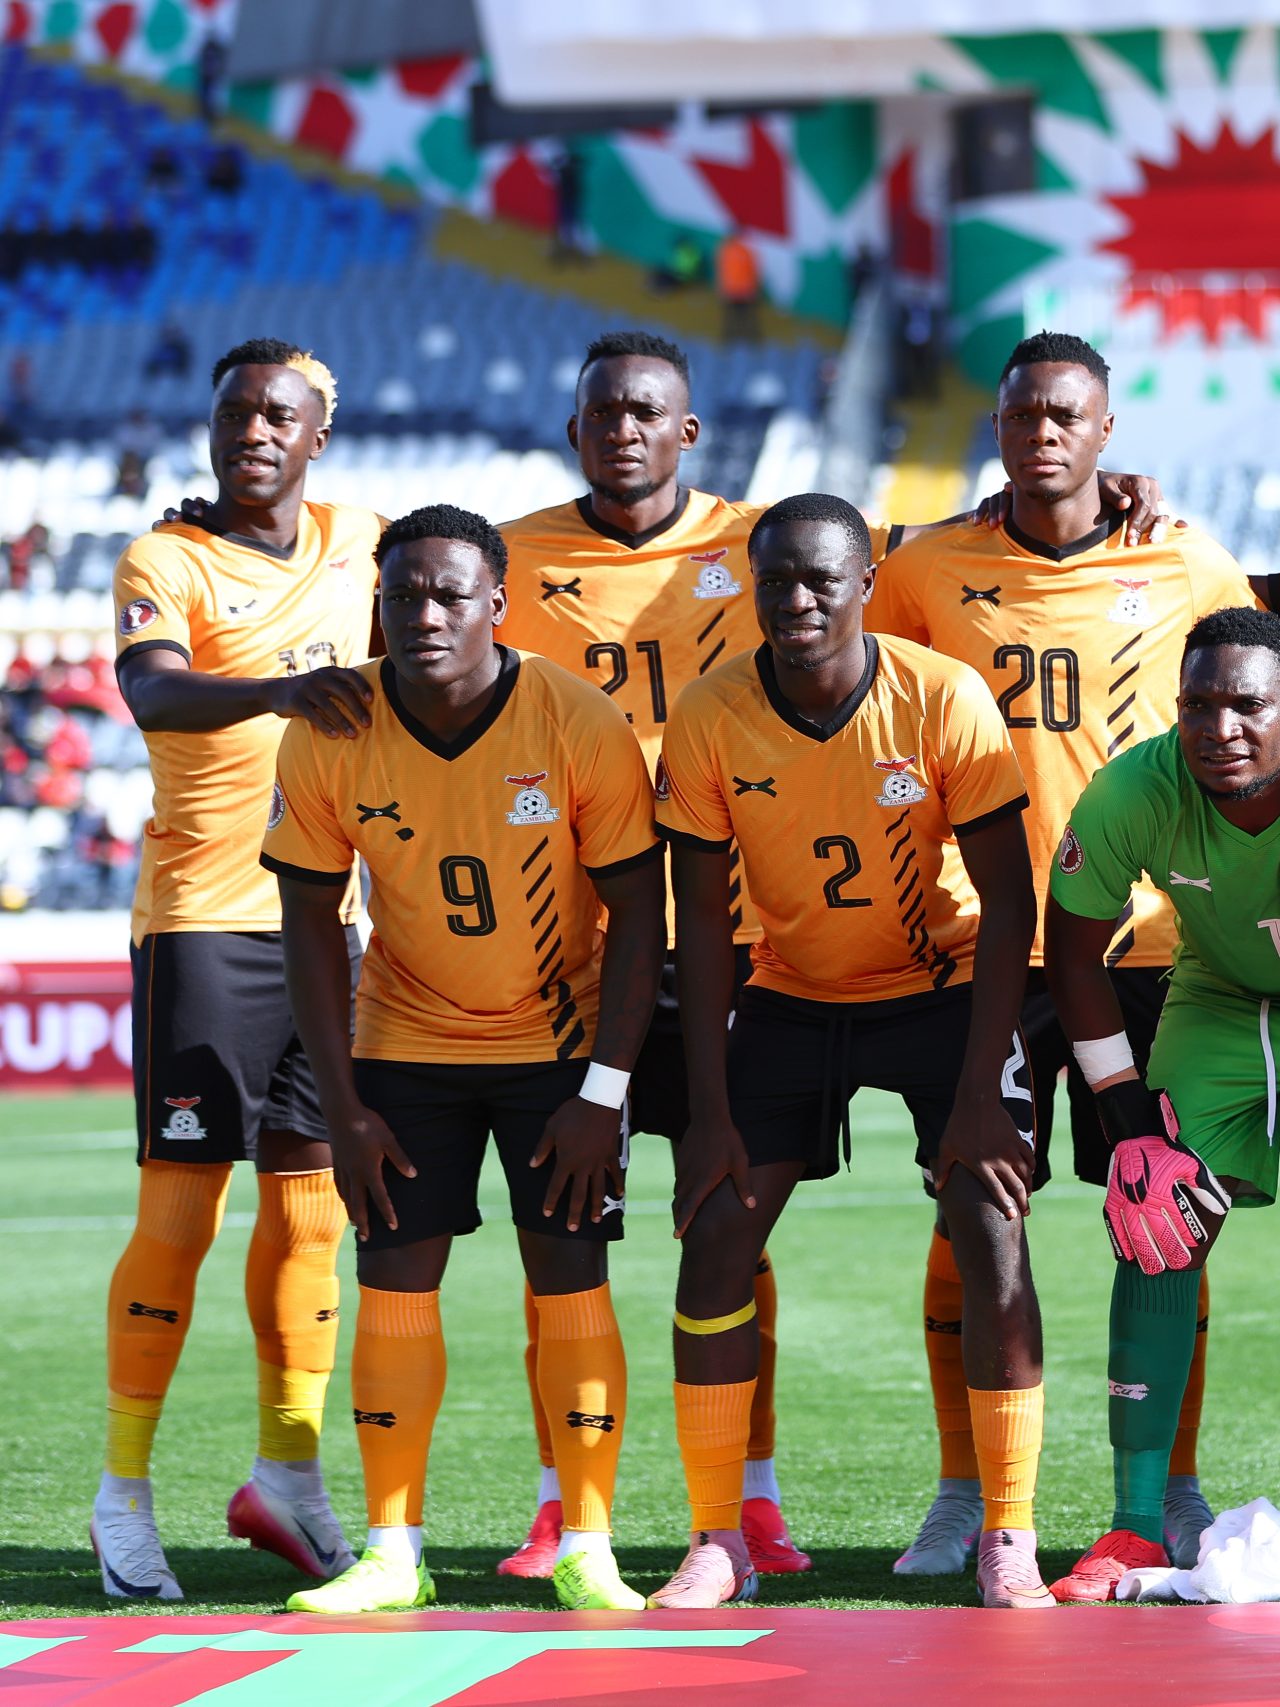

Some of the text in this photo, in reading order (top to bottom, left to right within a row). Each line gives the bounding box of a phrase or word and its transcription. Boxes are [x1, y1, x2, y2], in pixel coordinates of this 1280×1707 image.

[993, 644, 1080, 732] 20
[439, 855, 497, 936] 9
[813, 834, 872, 908] 2
[1176, 1198, 1203, 1240] HO SOCCER
